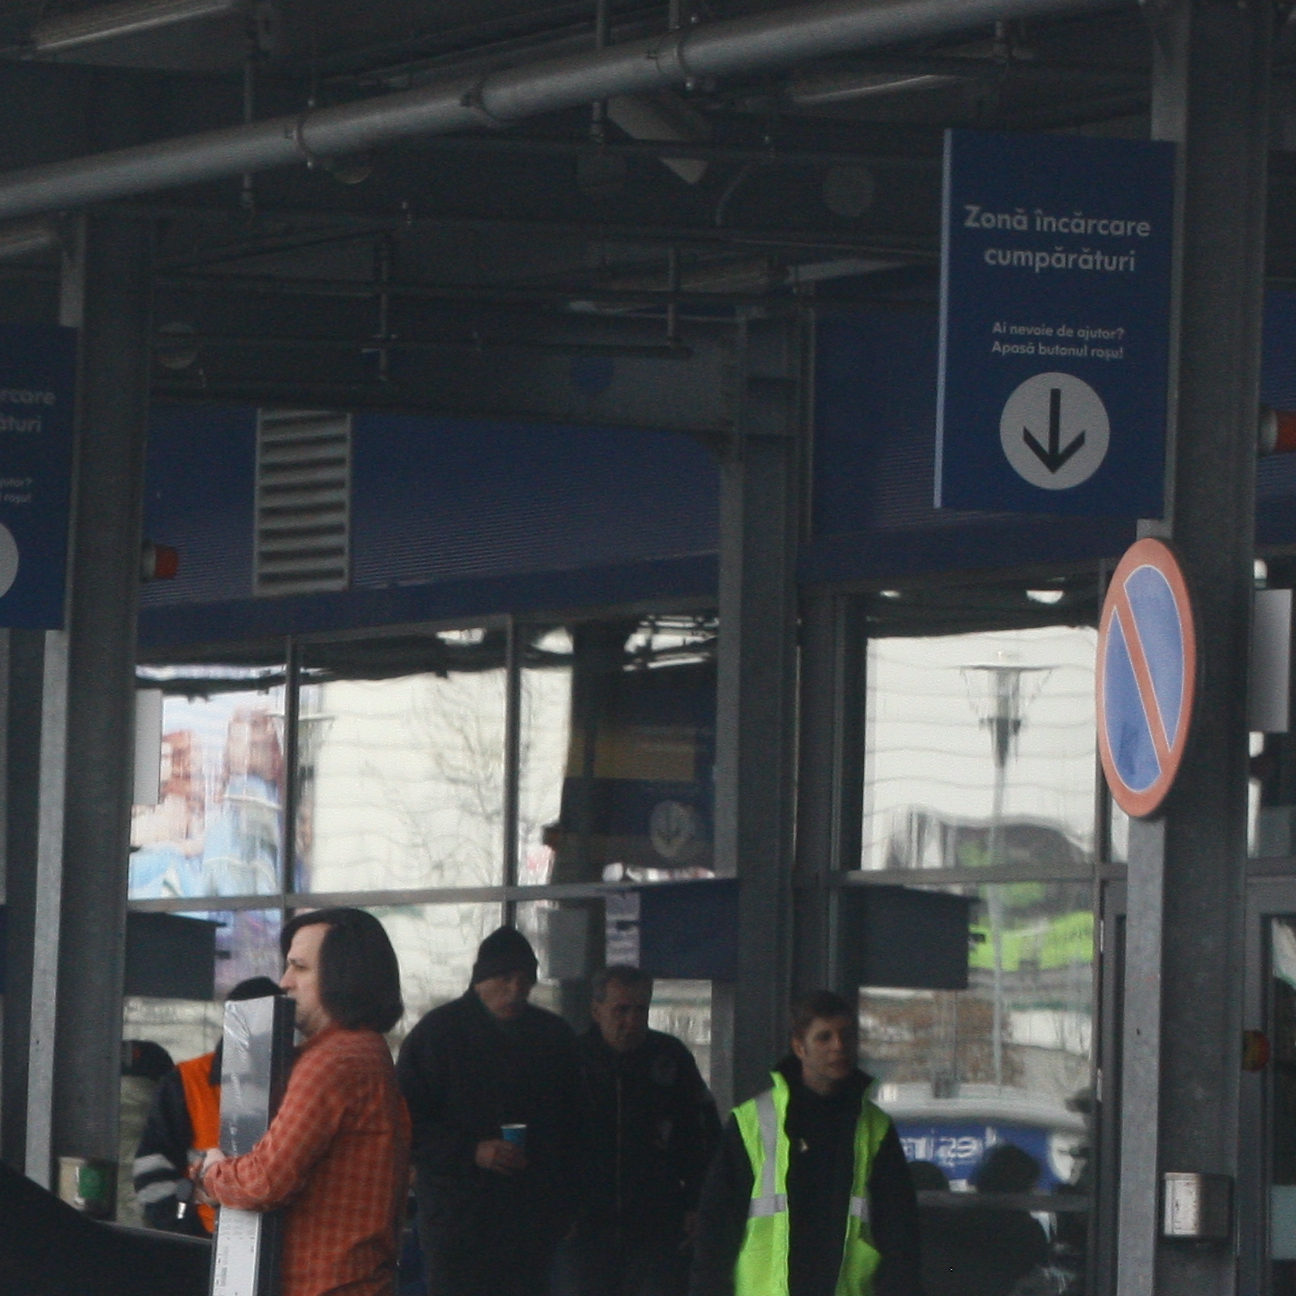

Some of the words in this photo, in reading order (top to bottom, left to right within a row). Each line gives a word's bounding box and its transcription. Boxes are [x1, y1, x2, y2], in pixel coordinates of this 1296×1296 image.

[963, 204, 1029, 231] Zonă
[1035, 210, 1151, 237] încărcare
[984, 245, 1136, 273] cumpărături
[992, 322, 1006, 334] Ai
[1010, 323, 1053, 336] nevoie
[1056, 325, 1074, 337] de
[1077, 326, 1125, 341] ajutor?
[991, 341, 1035, 355] Apasă
[1038, 342, 1087, 357] butonul
